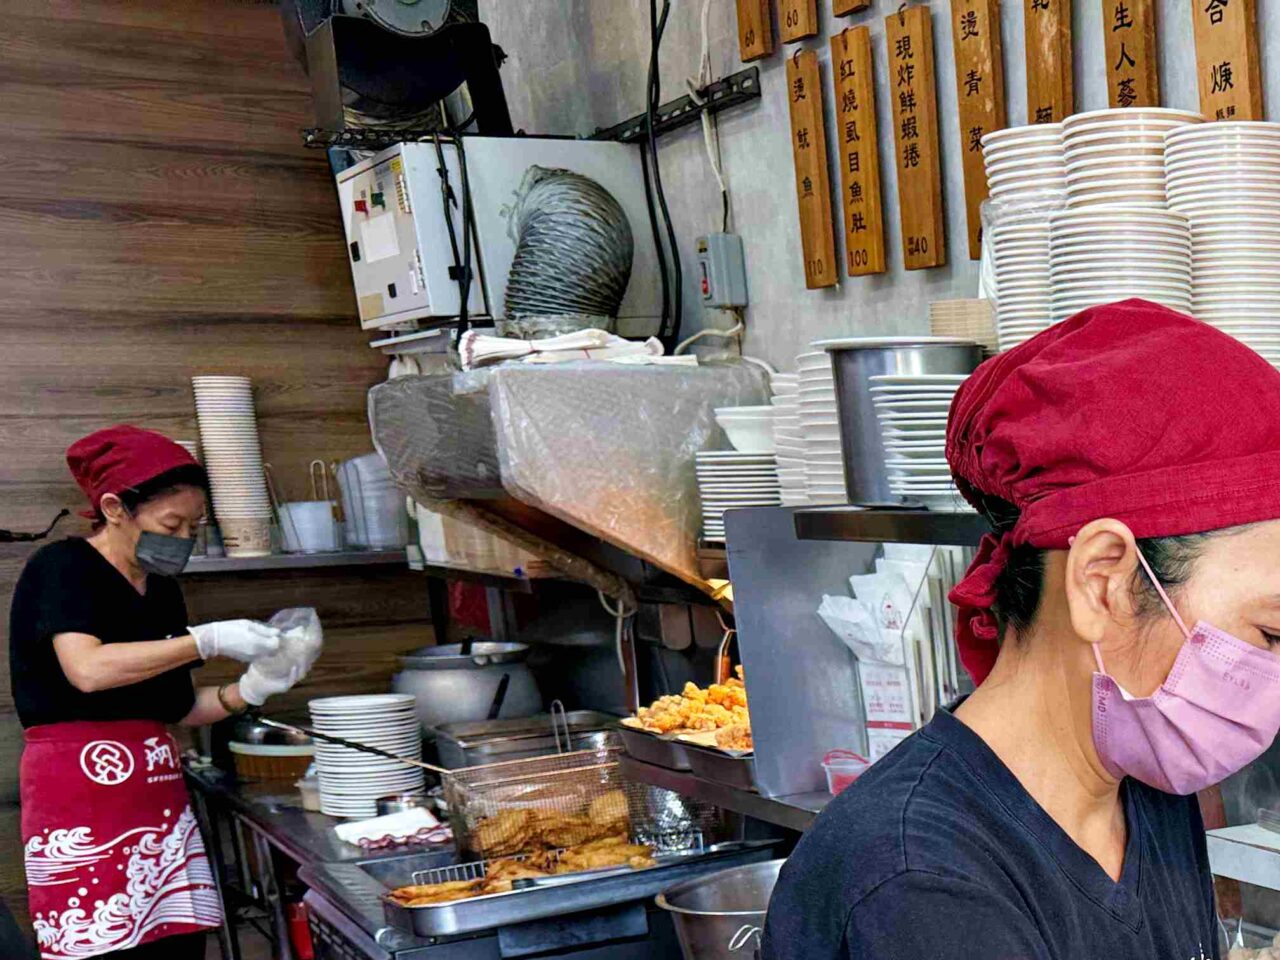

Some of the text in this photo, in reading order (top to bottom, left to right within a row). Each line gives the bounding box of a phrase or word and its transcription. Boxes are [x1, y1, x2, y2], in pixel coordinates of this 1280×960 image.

[786, 10, 799, 29] 60
[745, 29, 755, 48] 60
[895, 35, 920, 169] 現炸鮮蝦捲
[793, 77, 814, 200] 燙魷魚
[839, 59, 867, 234] 紅燒虱目魚肚
[807, 258, 823, 276] 110
[850, 248, 868, 267] 100
